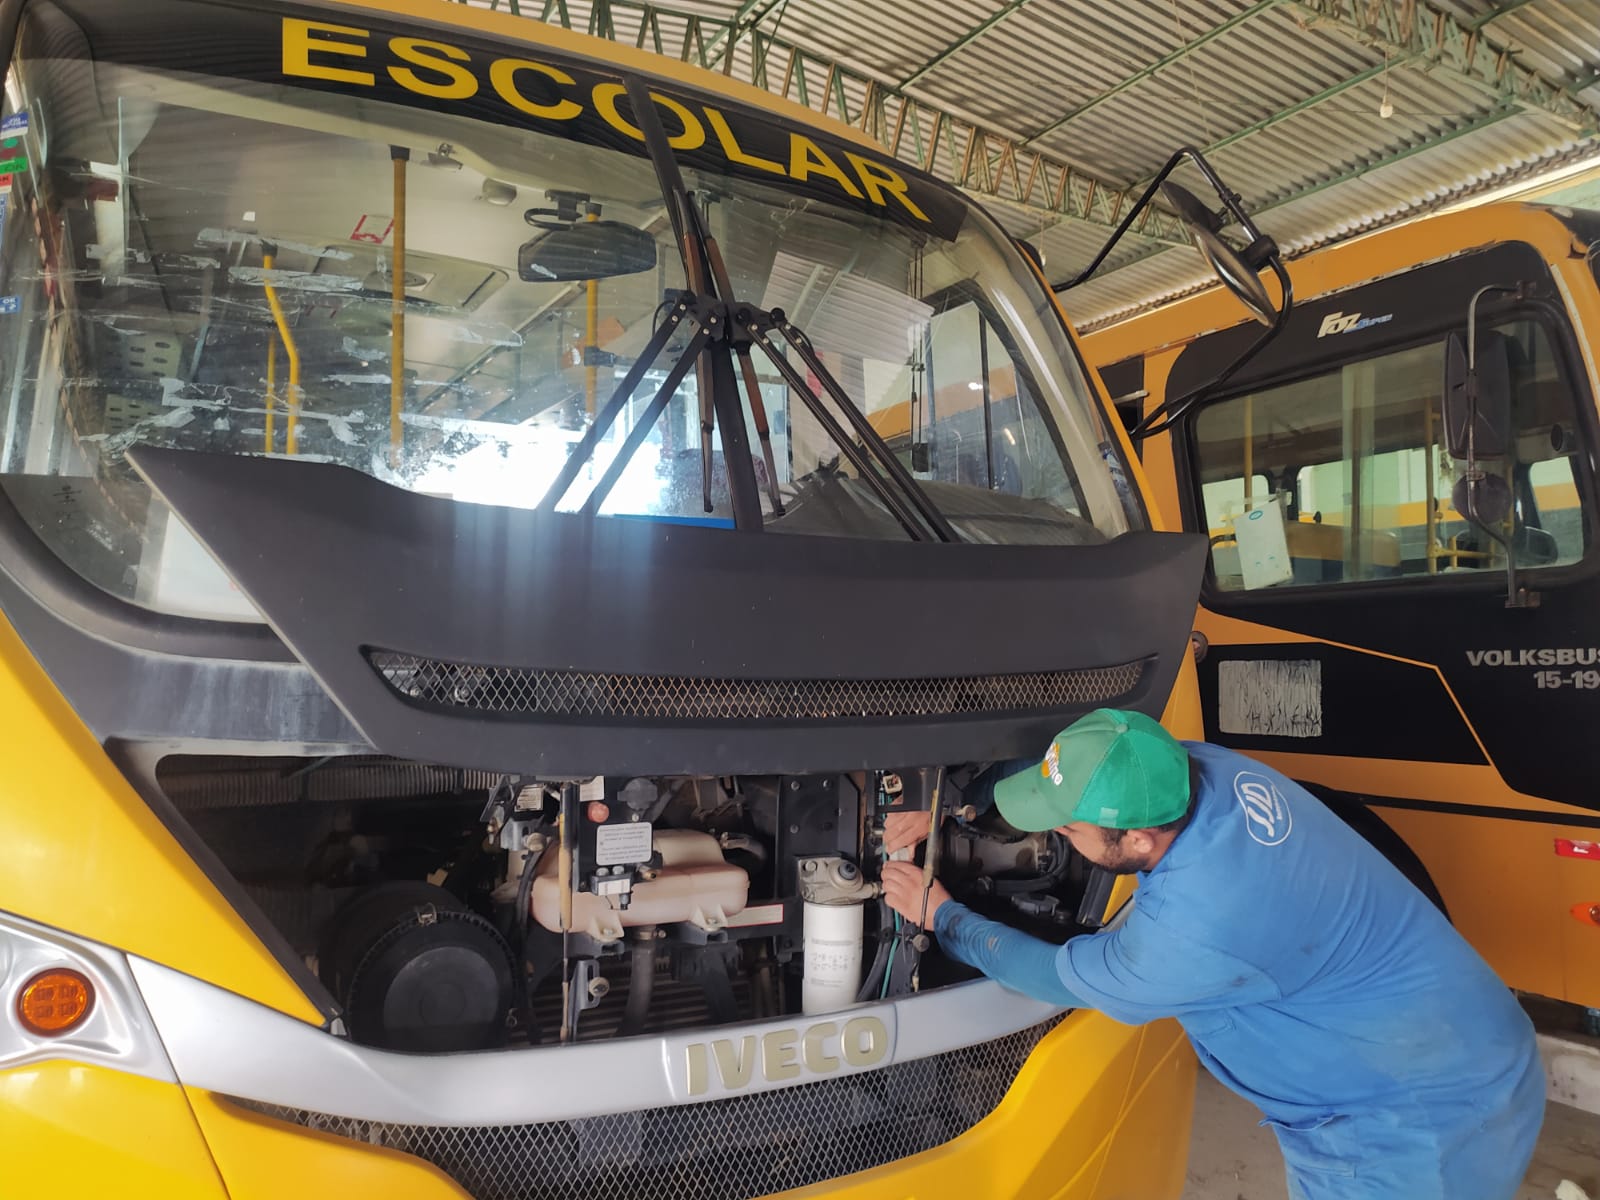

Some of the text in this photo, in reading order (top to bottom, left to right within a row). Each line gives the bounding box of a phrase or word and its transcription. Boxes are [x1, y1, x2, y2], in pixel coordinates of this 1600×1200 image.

[281, 18, 932, 222] ESCOLAR
[1465, 648, 1600, 666] VOLKSBU
[1533, 670, 1600, 689] 15-19
[685, 1016, 888, 1096] IVECO
